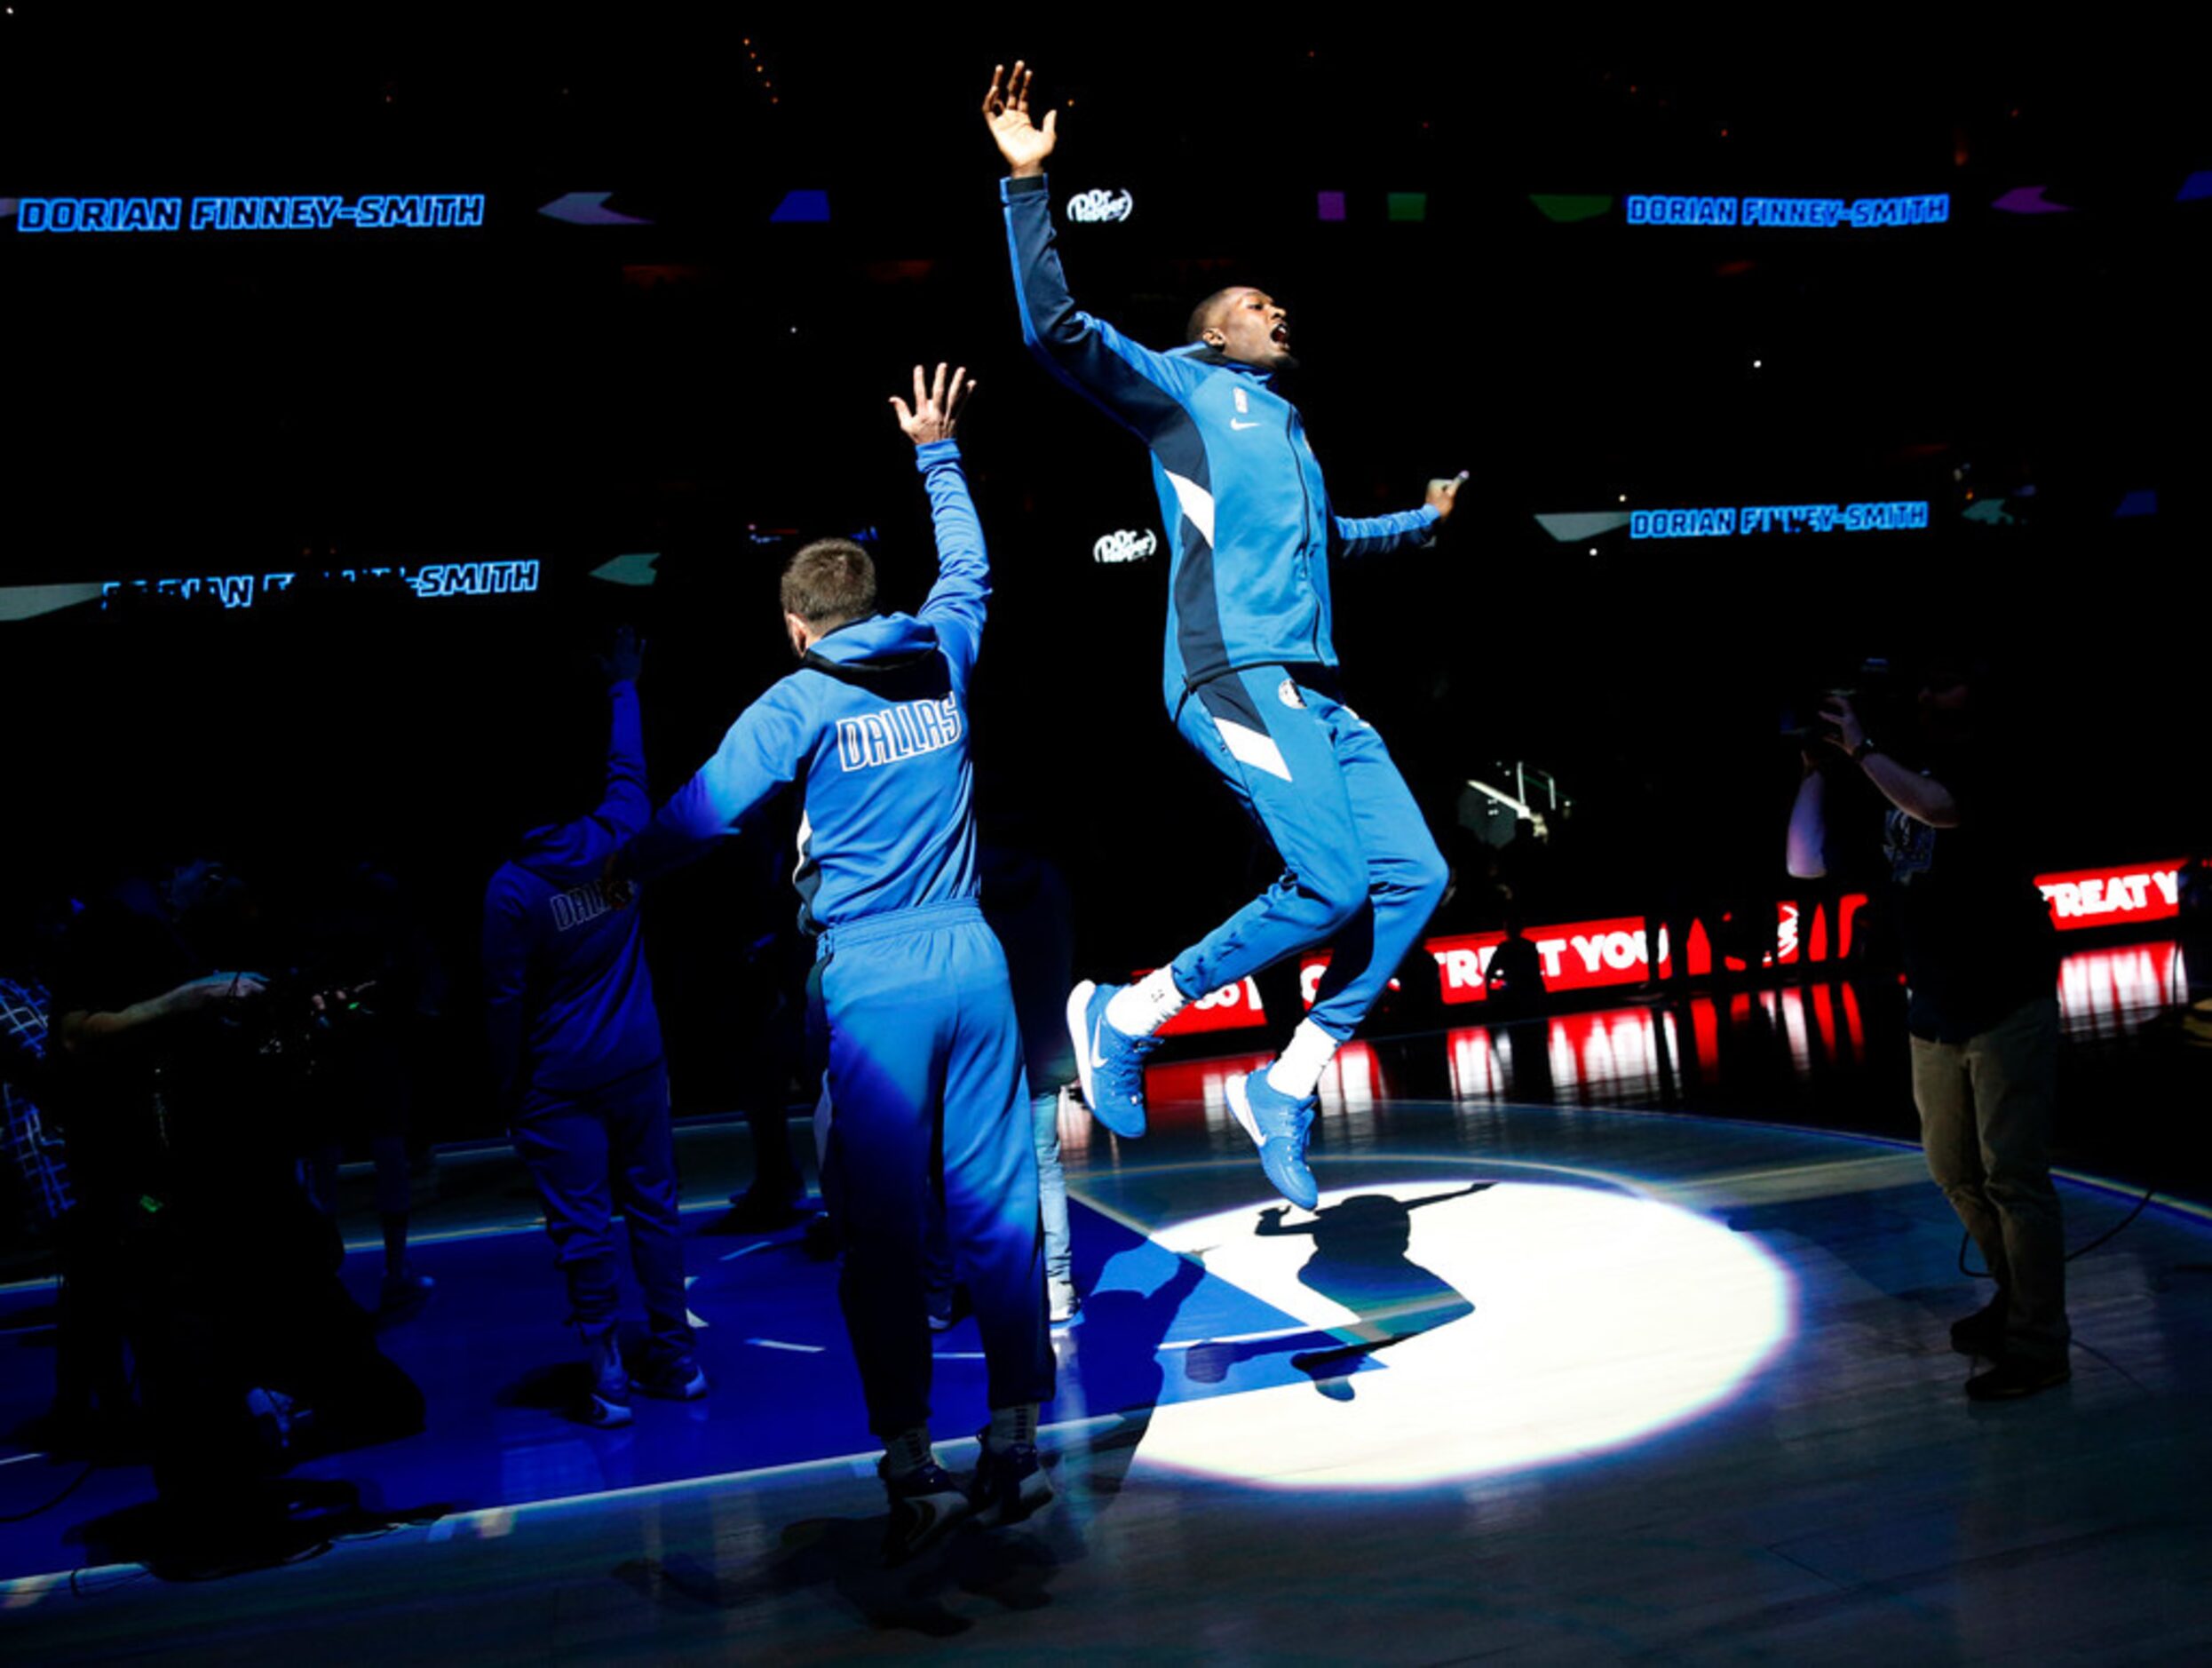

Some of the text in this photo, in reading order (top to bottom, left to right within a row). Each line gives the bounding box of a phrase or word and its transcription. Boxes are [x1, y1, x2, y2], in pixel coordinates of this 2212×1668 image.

[18, 195, 485, 232] DORIAN FINNEY-SMITH
[1627, 193, 1949, 227] DORIAN FINNEY-SMITH
[1630, 507, 1736, 538] DORIAN
[836, 691, 962, 772] DALLAS
[550, 877, 636, 933] DALL
